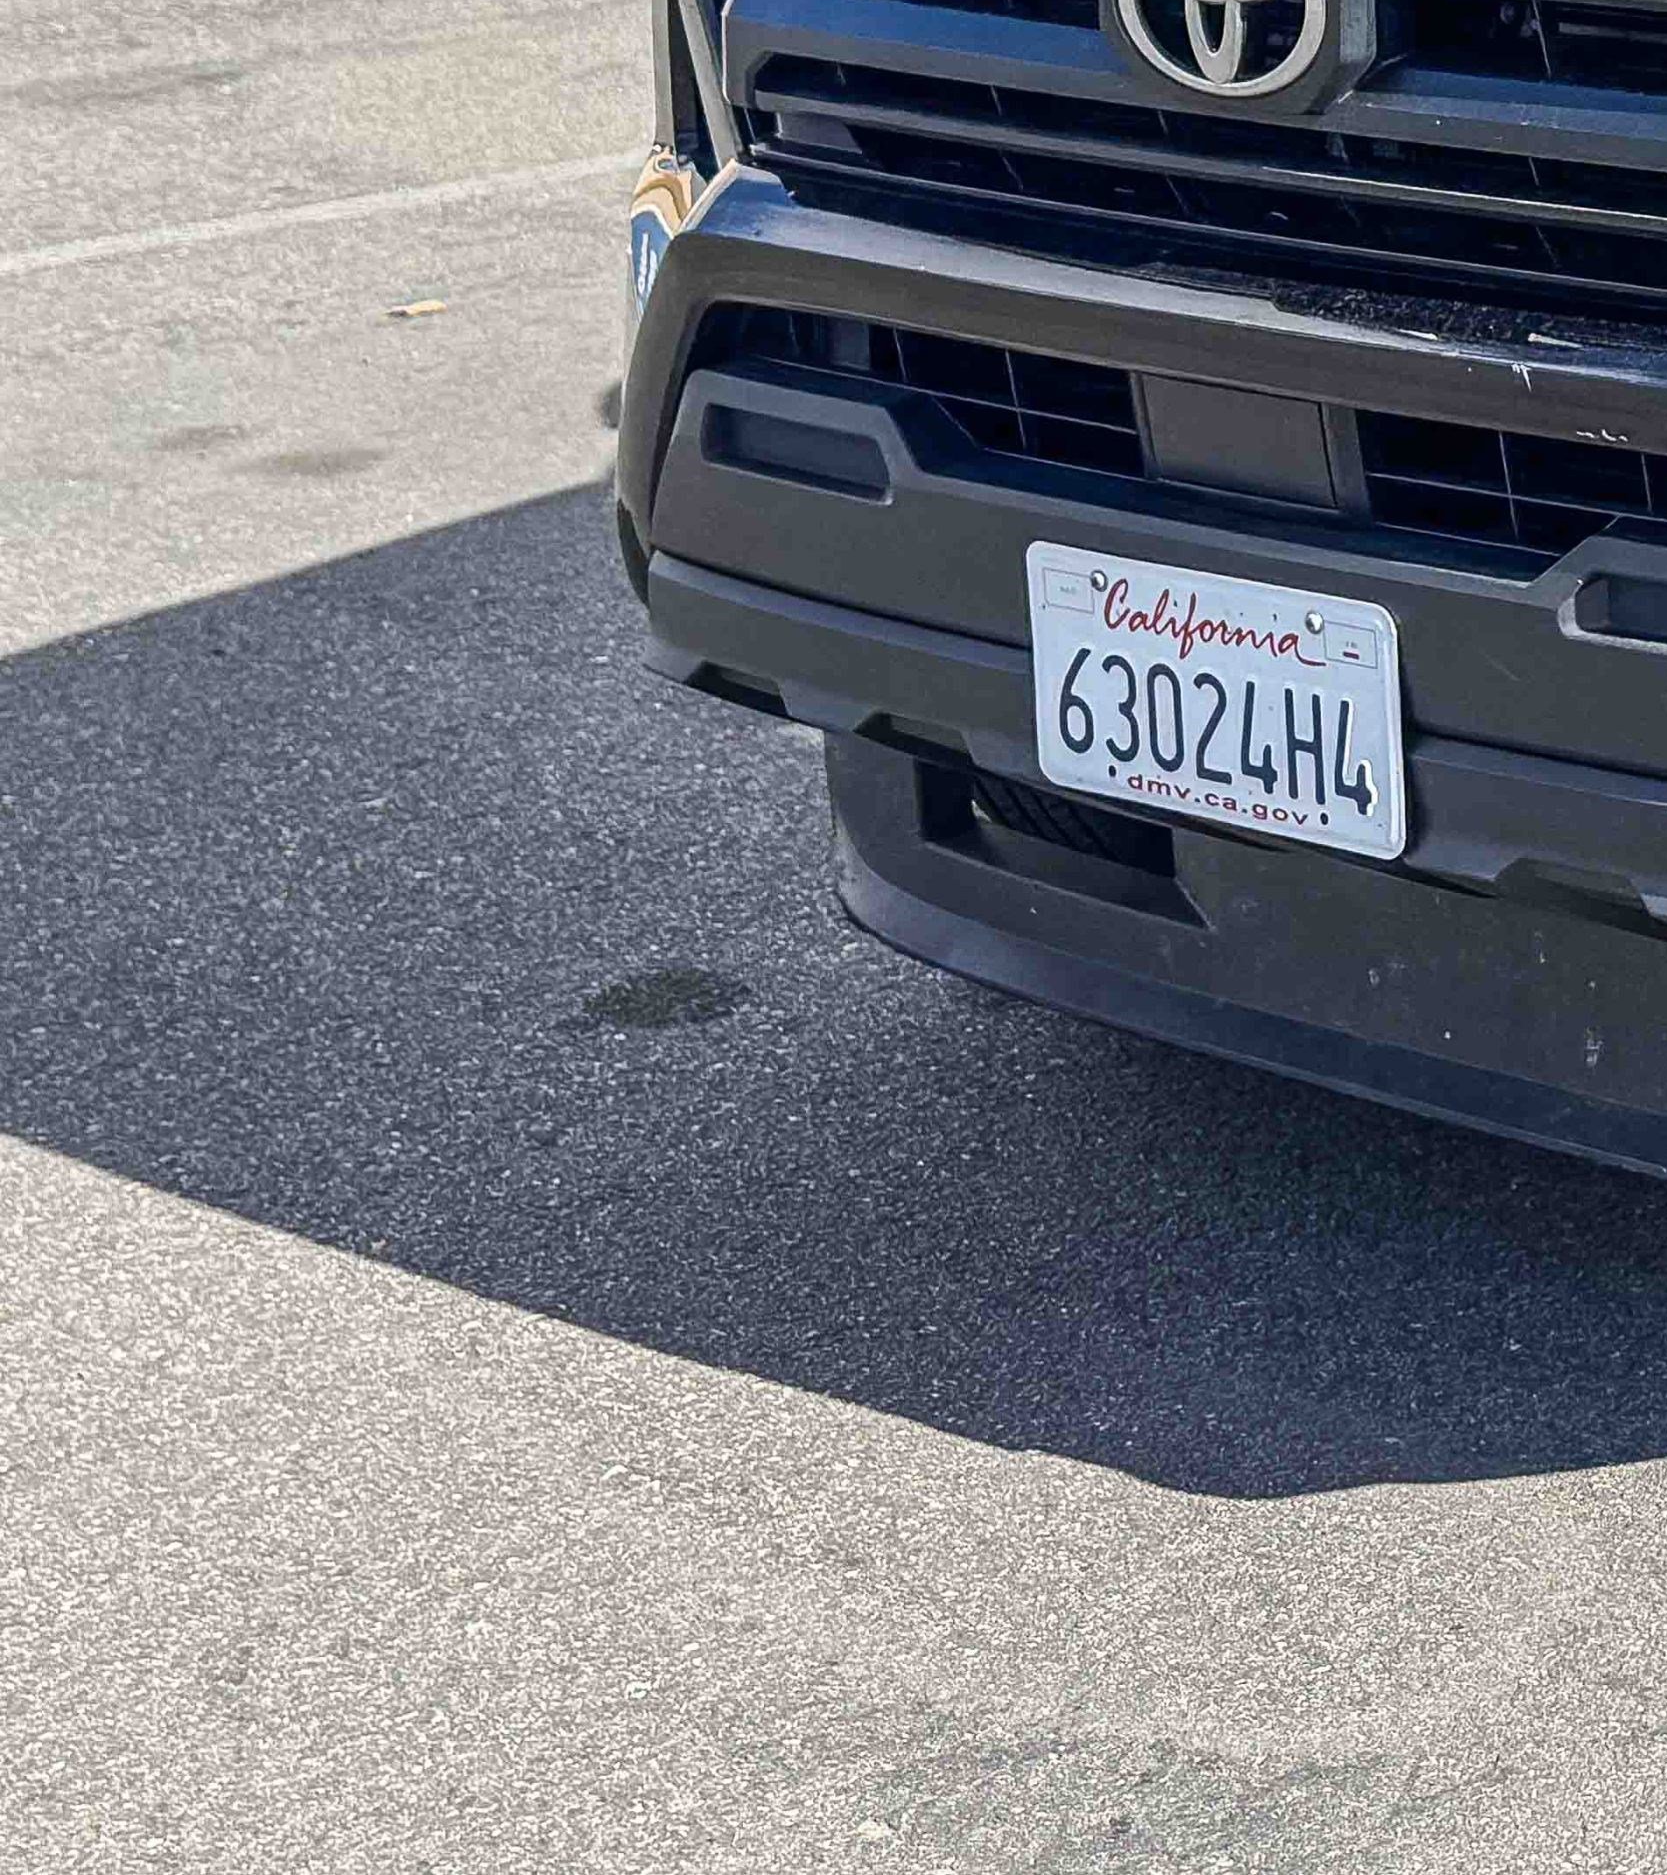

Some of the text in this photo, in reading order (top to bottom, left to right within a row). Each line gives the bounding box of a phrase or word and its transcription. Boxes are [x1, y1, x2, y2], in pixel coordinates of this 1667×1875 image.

[1104, 578, 1326, 666] California
[1059, 647, 1375, 816] 63024H4
[1127, 773, 1308, 826] dmv.ca.gov
